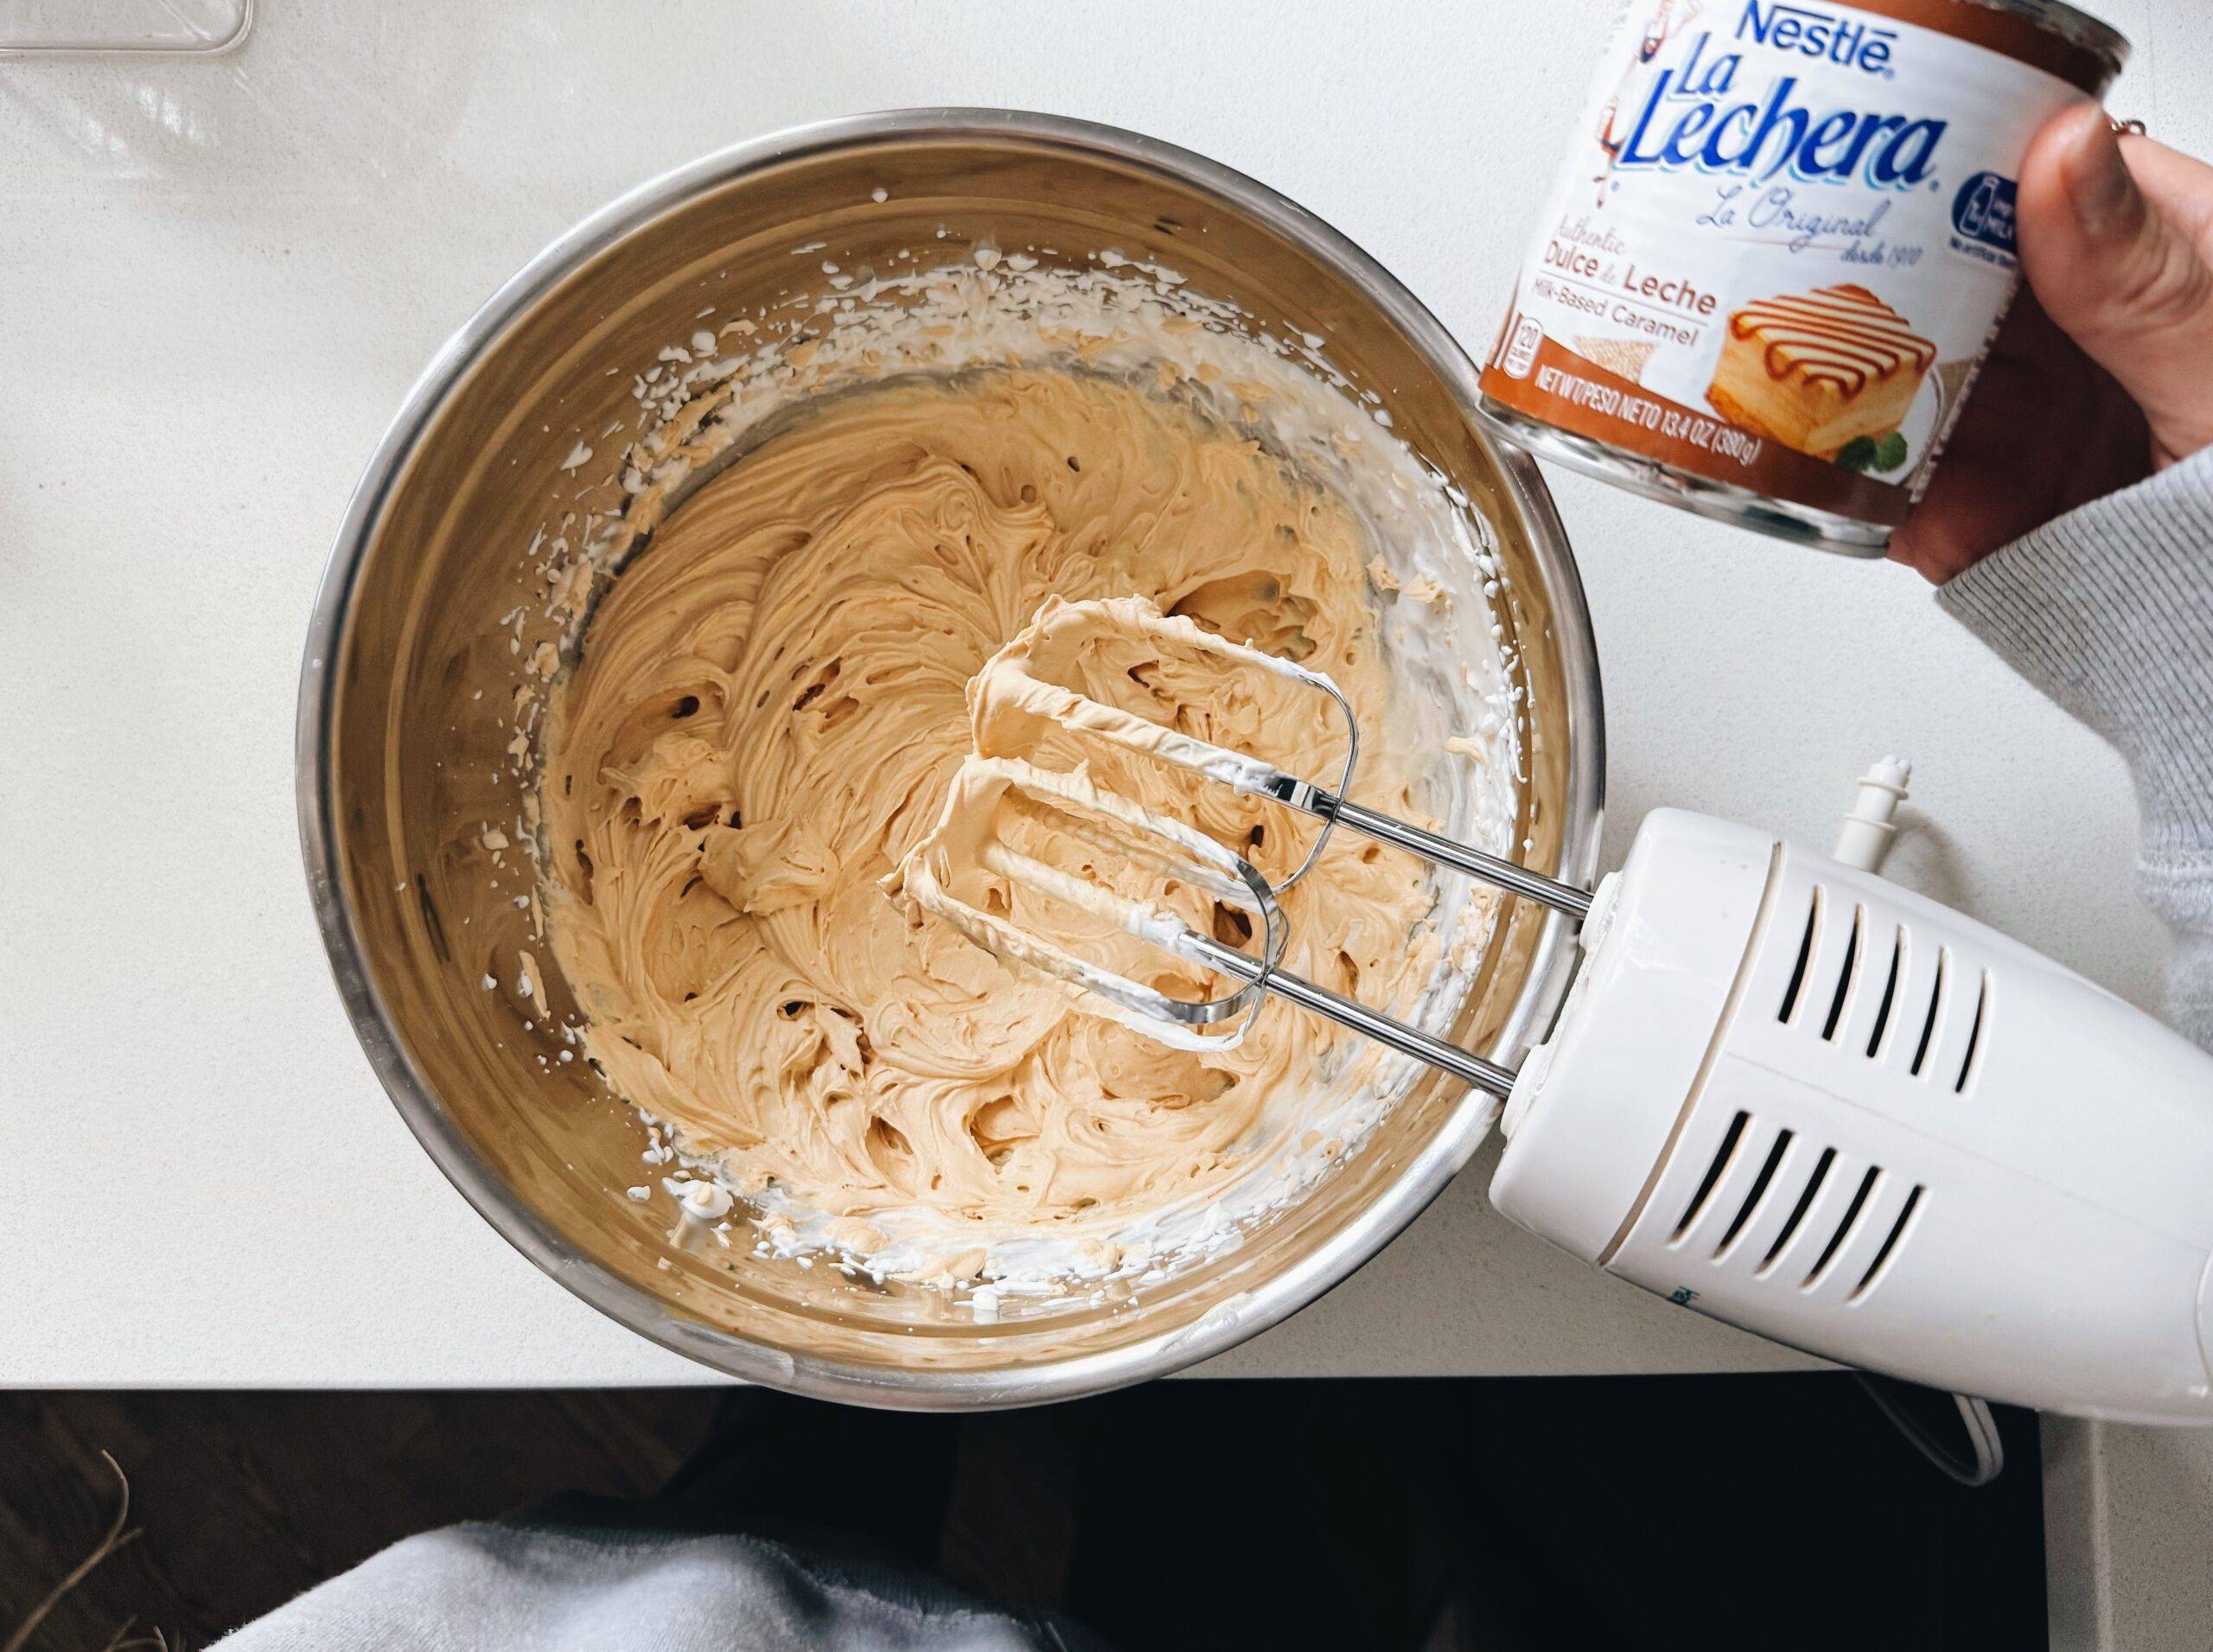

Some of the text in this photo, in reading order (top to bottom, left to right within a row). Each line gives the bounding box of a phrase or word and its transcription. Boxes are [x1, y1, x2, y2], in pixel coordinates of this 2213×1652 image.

[1673, 31, 1743, 95] La
[1735, 0, 1898, 73] Nestlé
[1619, 69, 1948, 185] Lechera
[1553, 214, 1626, 257] Authentic
[1696, 185, 1743, 228] La
[1748, 187, 1891, 253] Original
[1532, 277, 1700, 348] Milk-Based Caramel
[1544, 239, 1599, 277] Dulce
[1623, 265, 1718, 316] Leche
[1534, 364, 1563, 392] NET
[1617, 393, 1661, 431] NETO
[1661, 410, 1693, 440] 13.4
[1690, 418, 1717, 449] OZ
